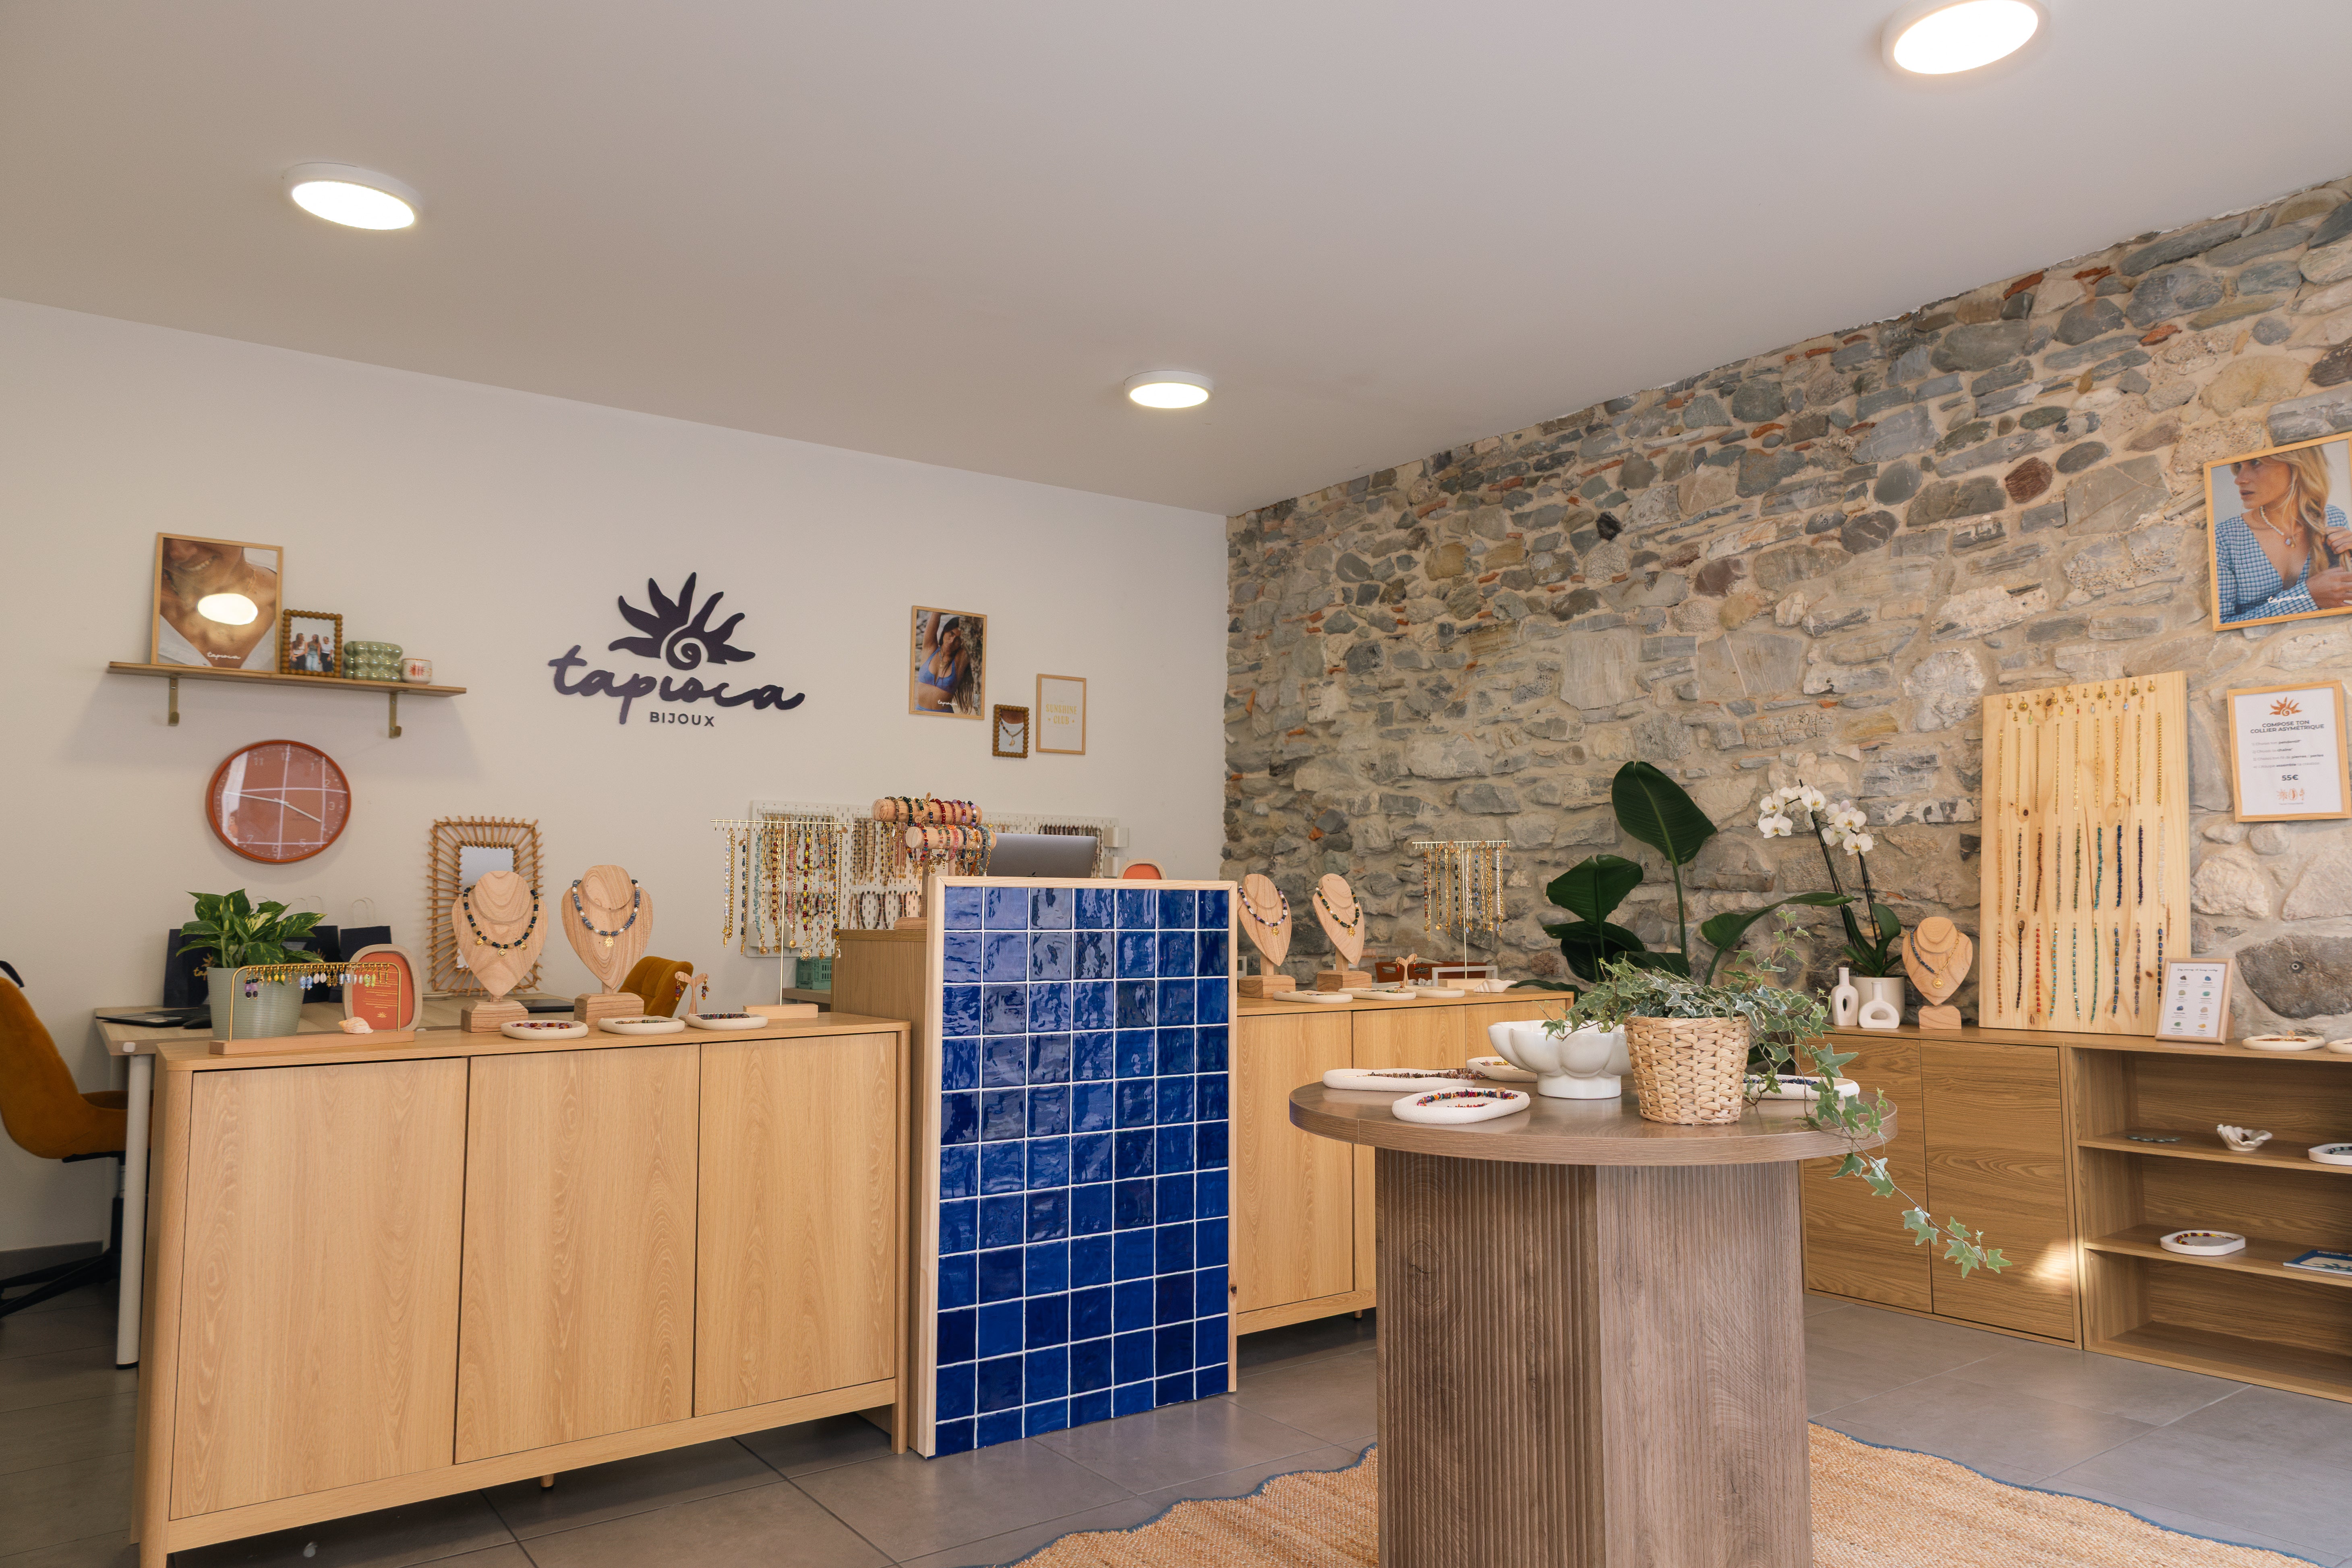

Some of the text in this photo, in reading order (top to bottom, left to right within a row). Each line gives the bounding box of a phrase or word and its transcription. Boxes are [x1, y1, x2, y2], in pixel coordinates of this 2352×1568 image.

[548, 645, 805, 725] tapioca
[1046, 703, 1077, 715] SUNSHINE
[650, 711, 715, 727] BIJOUX
[1053, 715, 1069, 725] CLUB
[323, 779, 331, 788] 2
[328, 802, 335, 811] 3
[299, 838, 306, 847] 5
